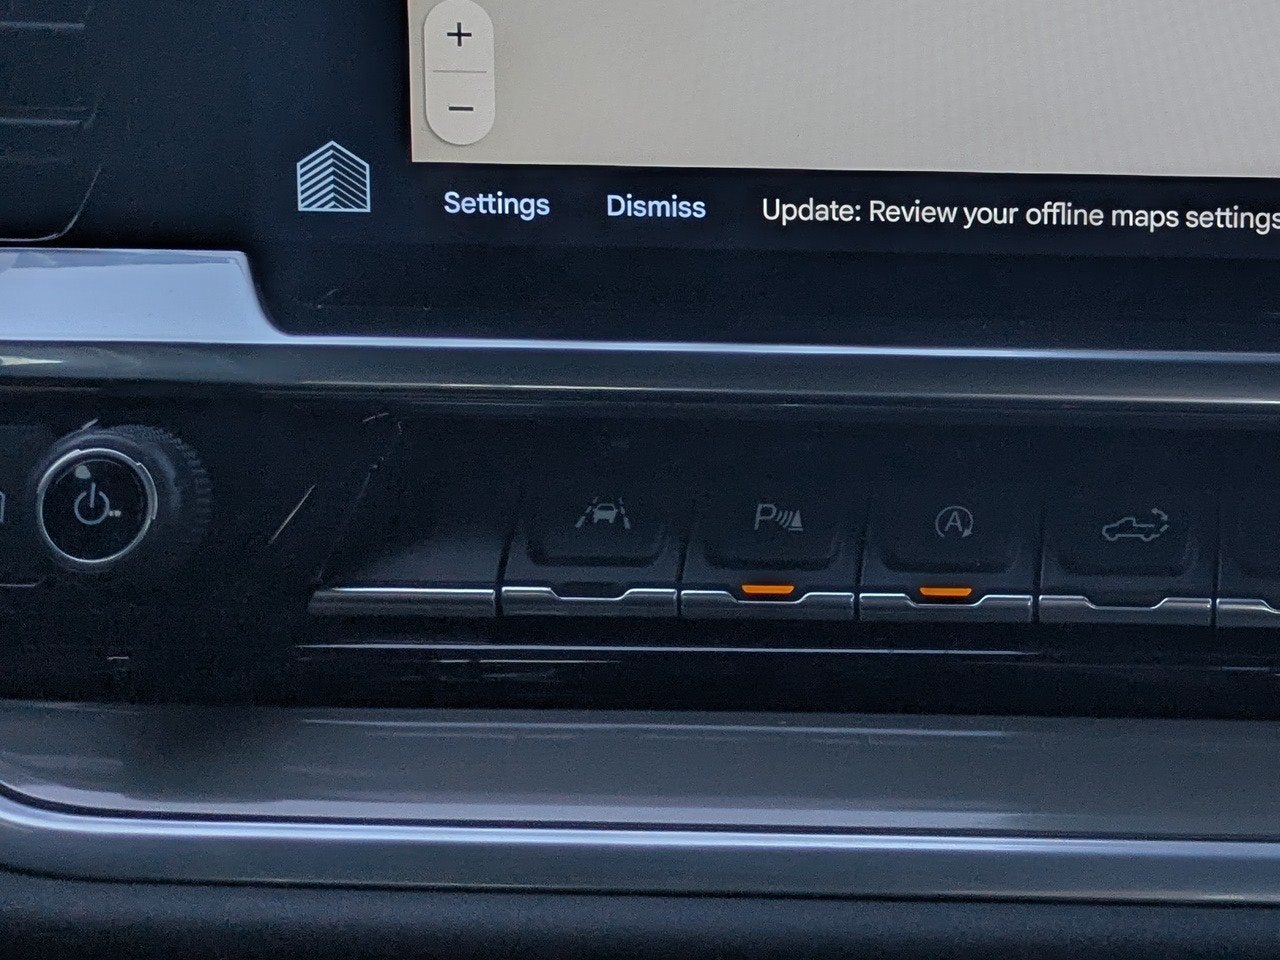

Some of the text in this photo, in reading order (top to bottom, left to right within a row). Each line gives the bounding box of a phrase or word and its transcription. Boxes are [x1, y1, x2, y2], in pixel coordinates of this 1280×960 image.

[443, 190, 550, 221] Settings
[607, 193, 707, 219] Dismiss
[762, 197, 861, 226] Update:
[869, 199, 958, 224] Review
[962, 206, 1019, 230] your
[1025, 200, 1105, 227] offline
[1111, 209, 1180, 233] maps
[754, 503, 777, 531] P
[945, 511, 964, 532] A
